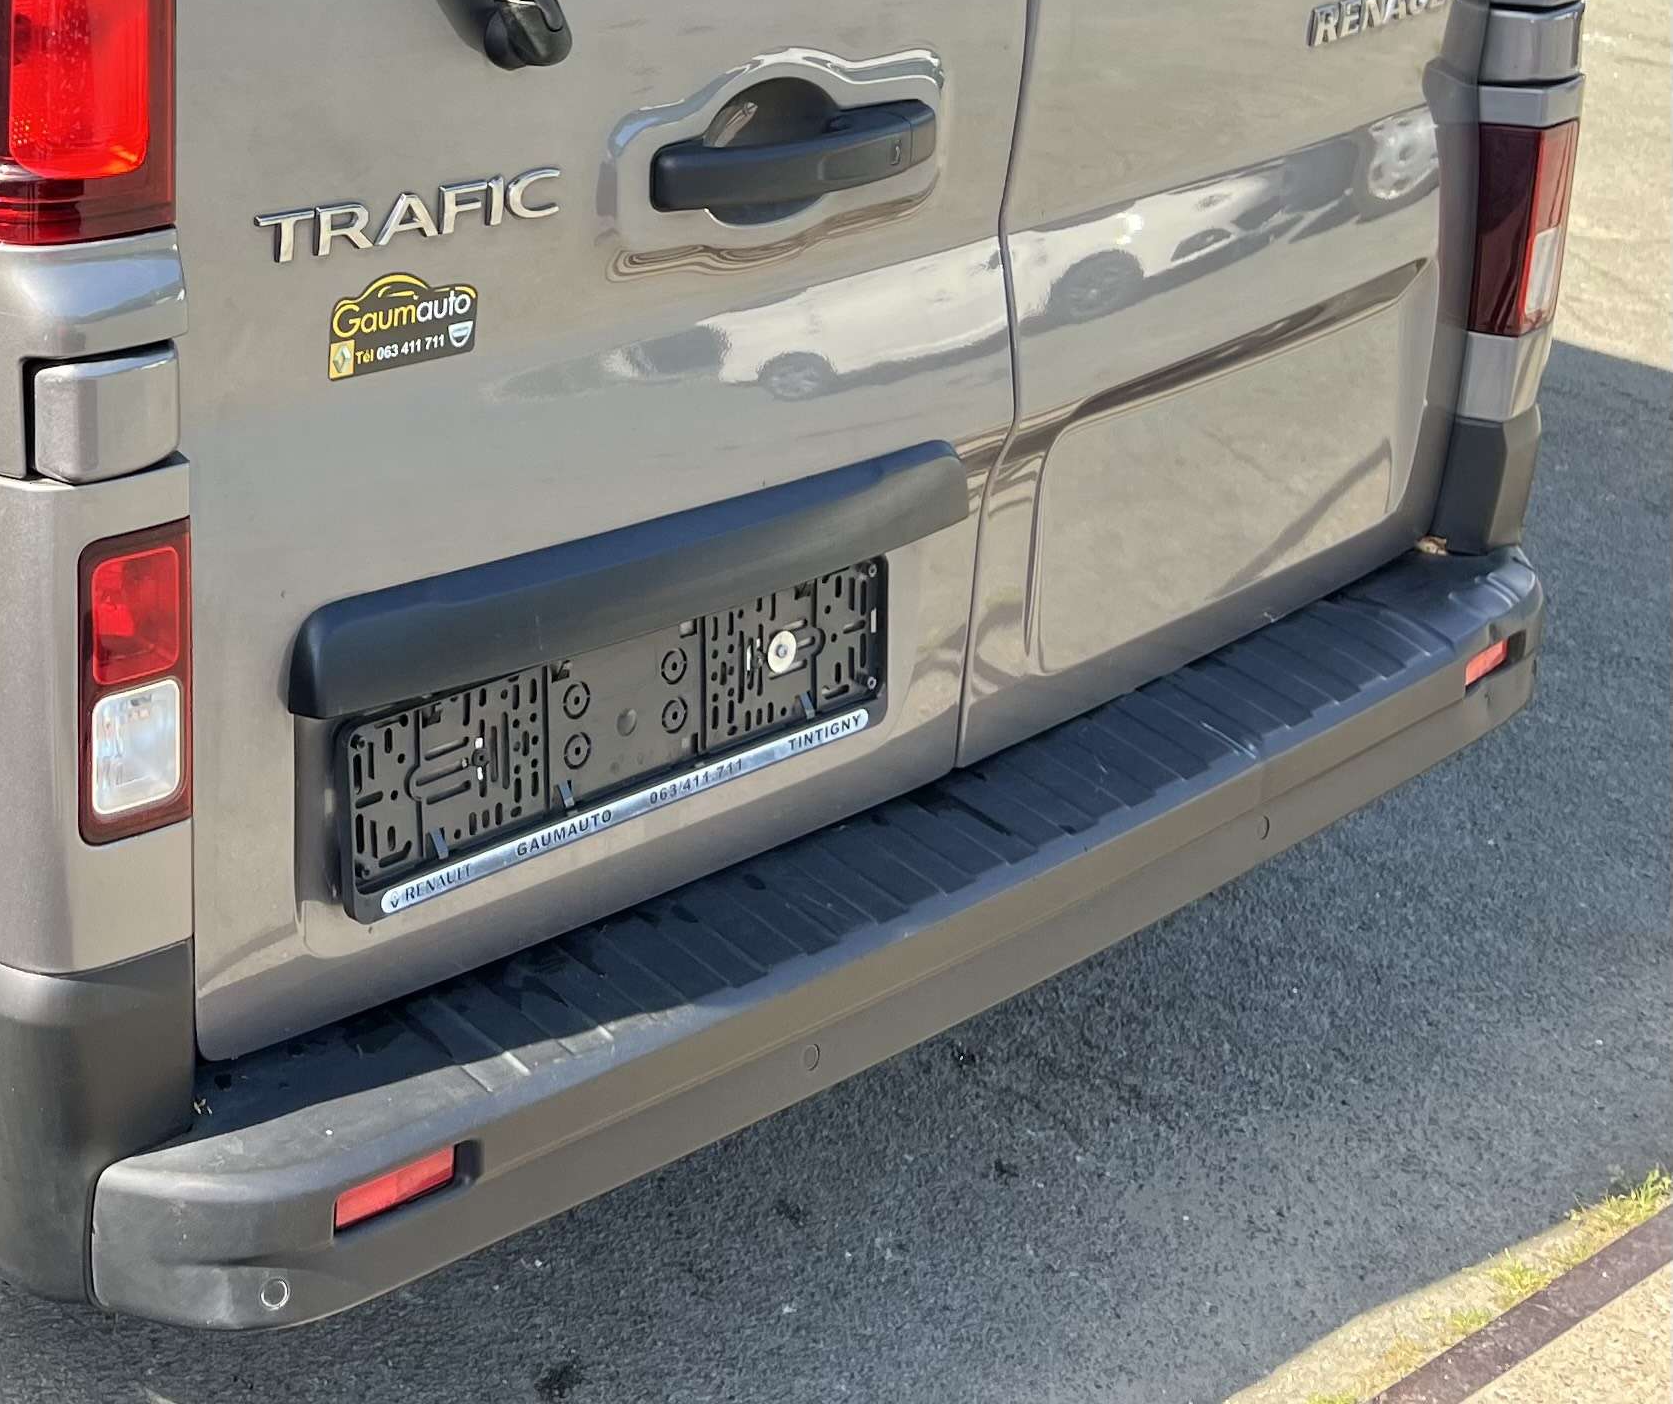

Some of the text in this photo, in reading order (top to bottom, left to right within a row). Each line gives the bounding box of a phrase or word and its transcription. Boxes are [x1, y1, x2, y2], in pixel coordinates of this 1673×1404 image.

[254, 167, 561, 263] TRAFIC
[332, 291, 472, 338] Gaumauto
[377, 346, 399, 361] 063
[401, 339, 422, 356] 411
[425, 334, 445, 351] 711
[404, 863, 472, 902] RENAULT
[517, 809, 612, 857] GAUMAUTO
[788, 714, 861, 751] TINTIGNY
